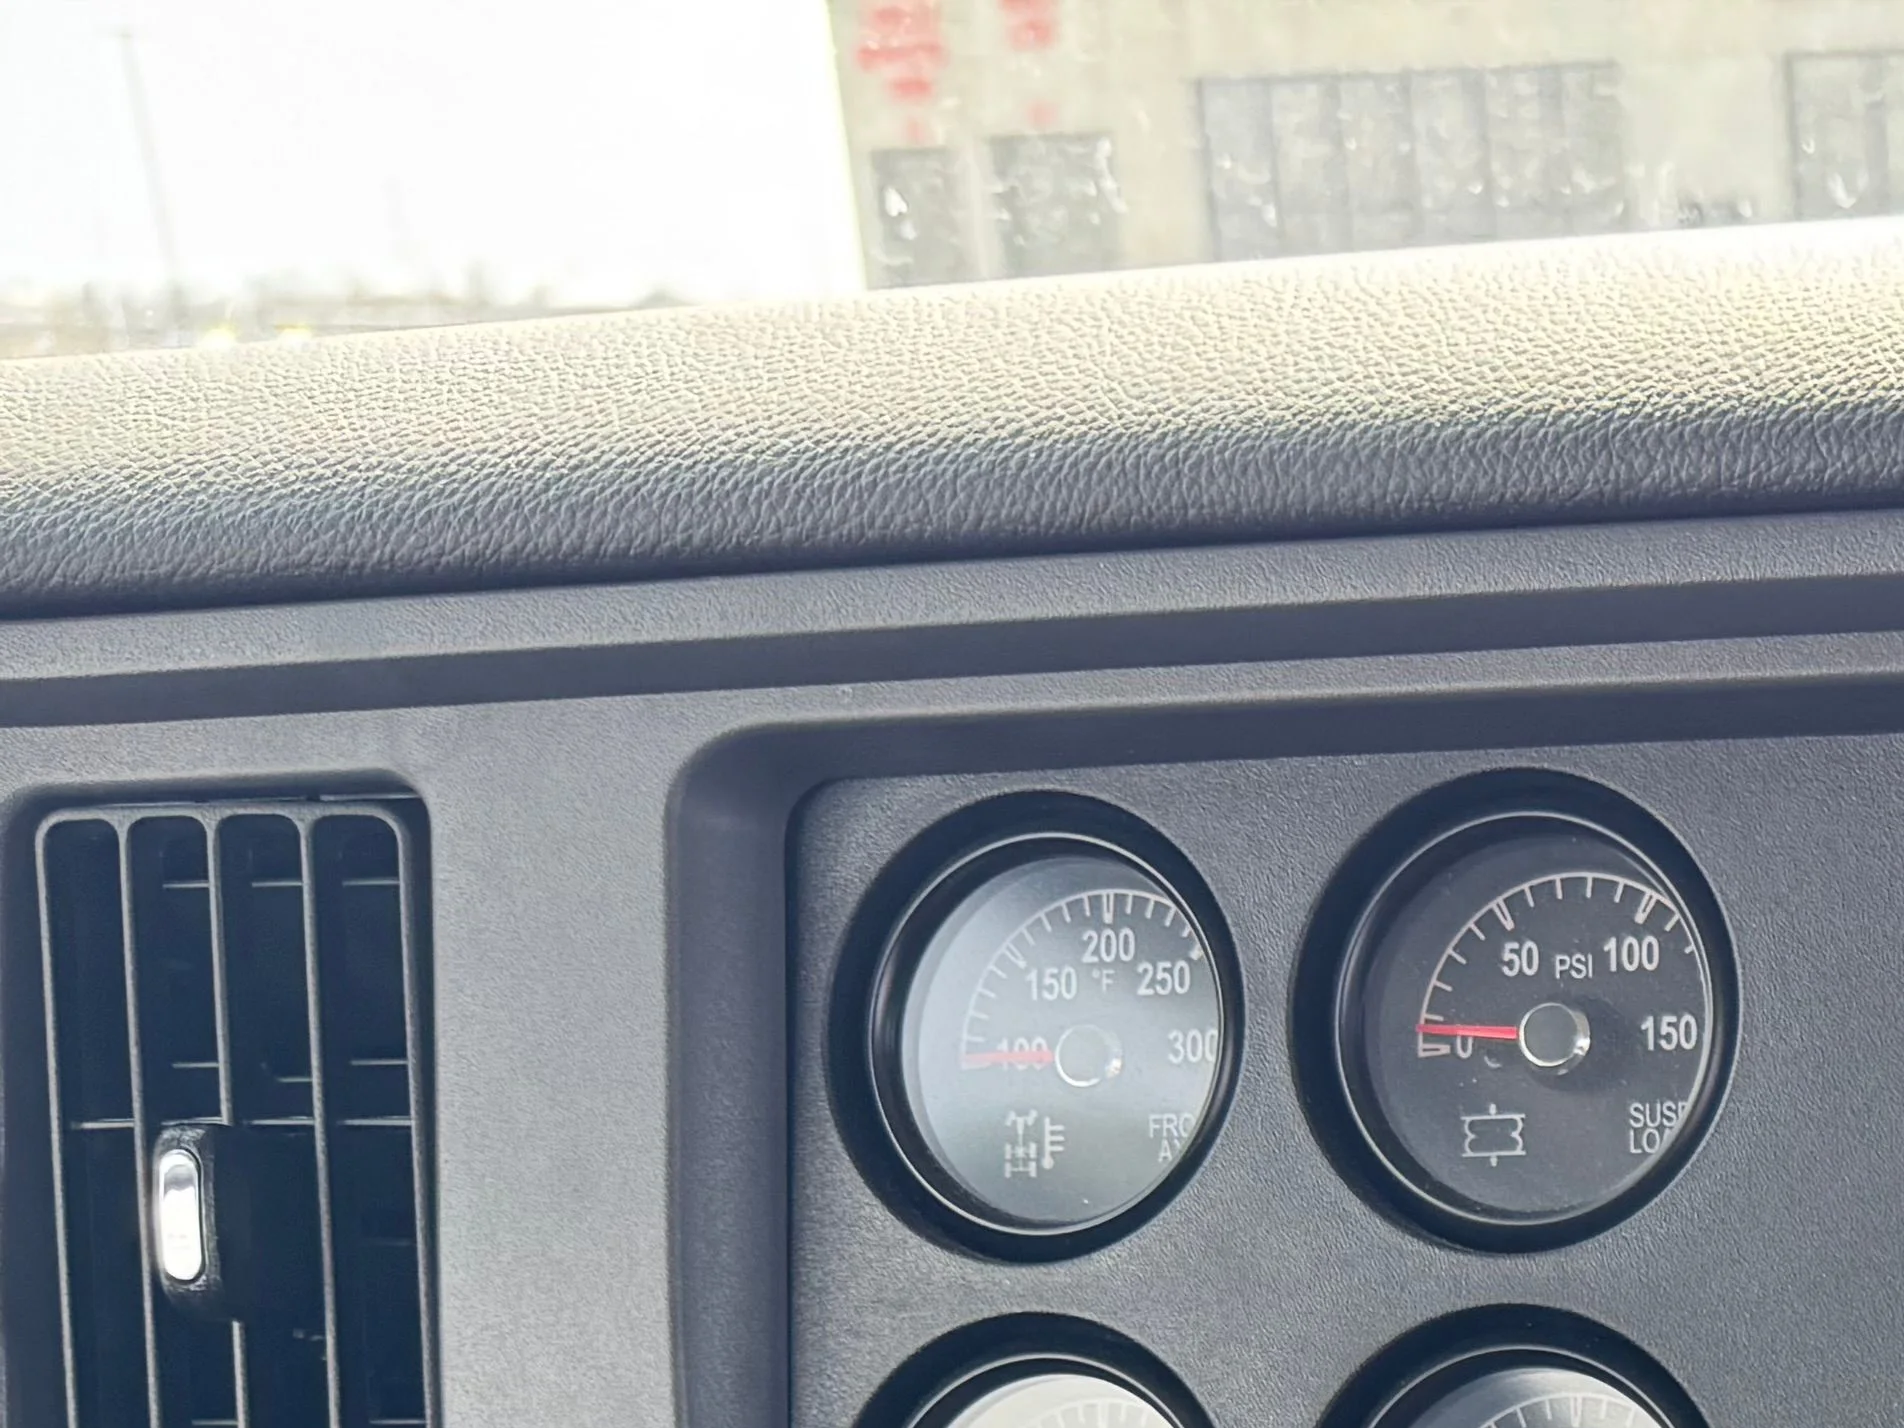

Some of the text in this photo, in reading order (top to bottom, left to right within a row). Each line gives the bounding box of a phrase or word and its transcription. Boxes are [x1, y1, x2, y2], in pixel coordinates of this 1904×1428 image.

[1081, 927, 1136, 964] 200
[1502, 940, 1540, 977] 50
[1603, 935, 1660, 972] 100
[1024, 965, 1078, 1001] 150
[1136, 961, 1191, 996] 250
[1554, 953, 1594, 979] PSI
[1167, 1028, 1219, 1065] 300
[1641, 1014, 1699, 1051] 150
